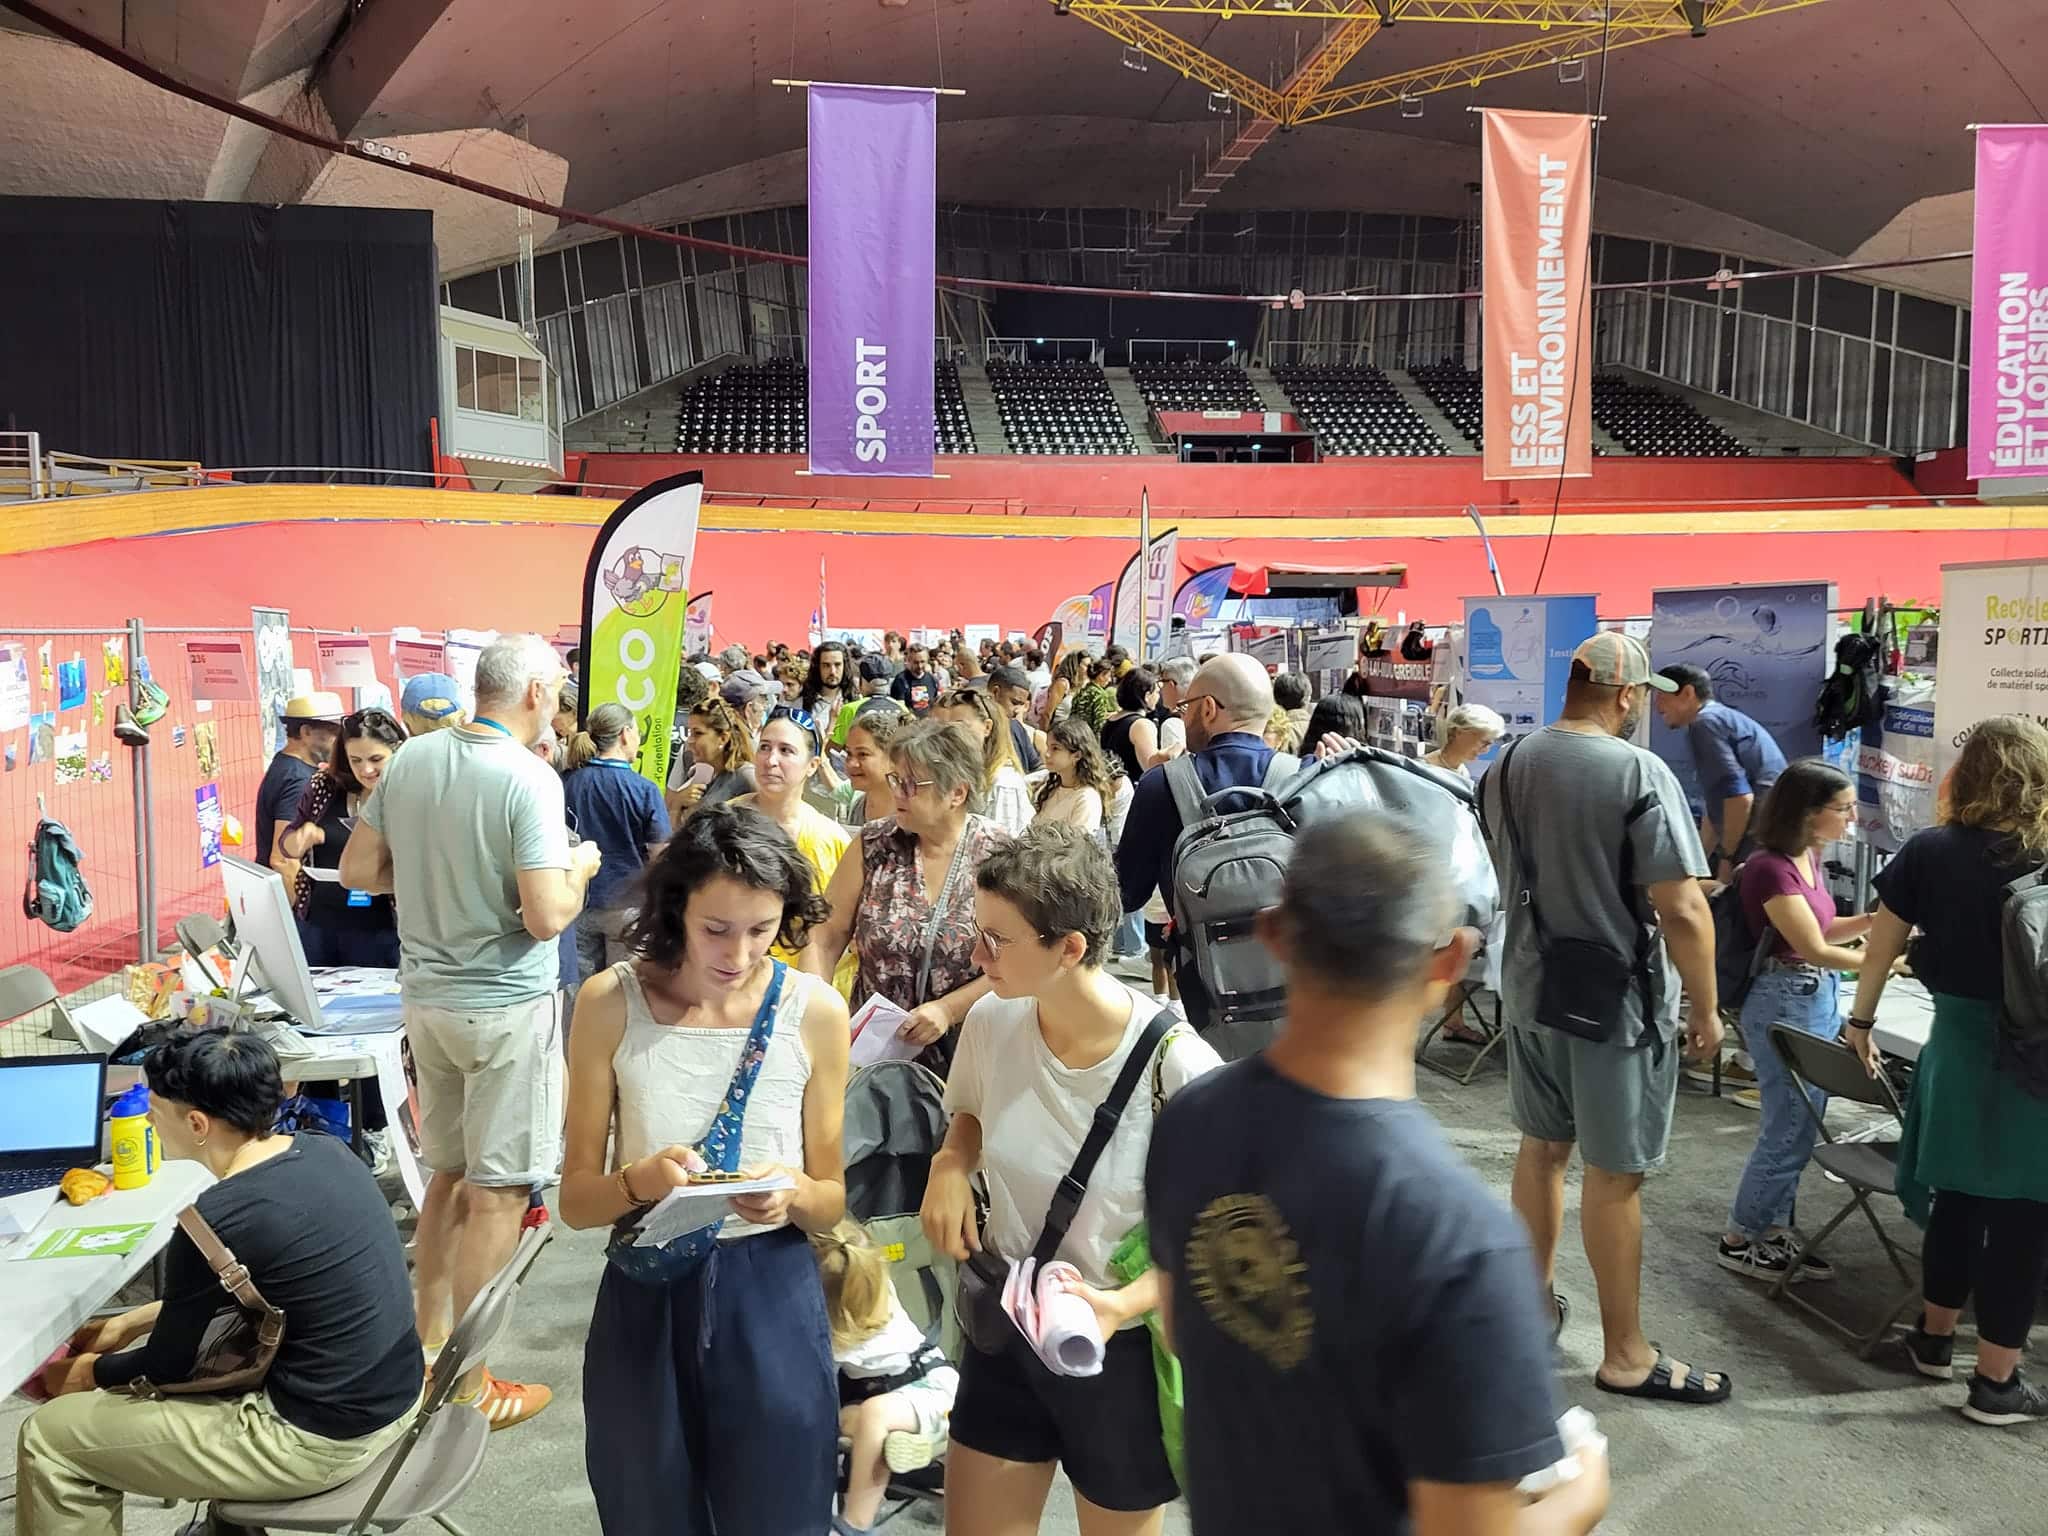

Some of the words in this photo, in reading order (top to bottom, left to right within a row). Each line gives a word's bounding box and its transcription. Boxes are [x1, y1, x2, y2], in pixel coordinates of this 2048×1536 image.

[1536, 153, 1568, 467] ENVIRONNEMENT
[1511, 352, 1538, 397] ET
[1989, 272, 2029, 467] ÉDUCATION
[2025, 286, 2048, 419] LOISIRS
[855, 337, 887, 463] SPORT
[1511, 402, 1538, 468] ESS
[2025, 425, 2048, 467] ET
[1987, 680, 1998, 689] de
[1991, 667, 2023, 678] Collecte
